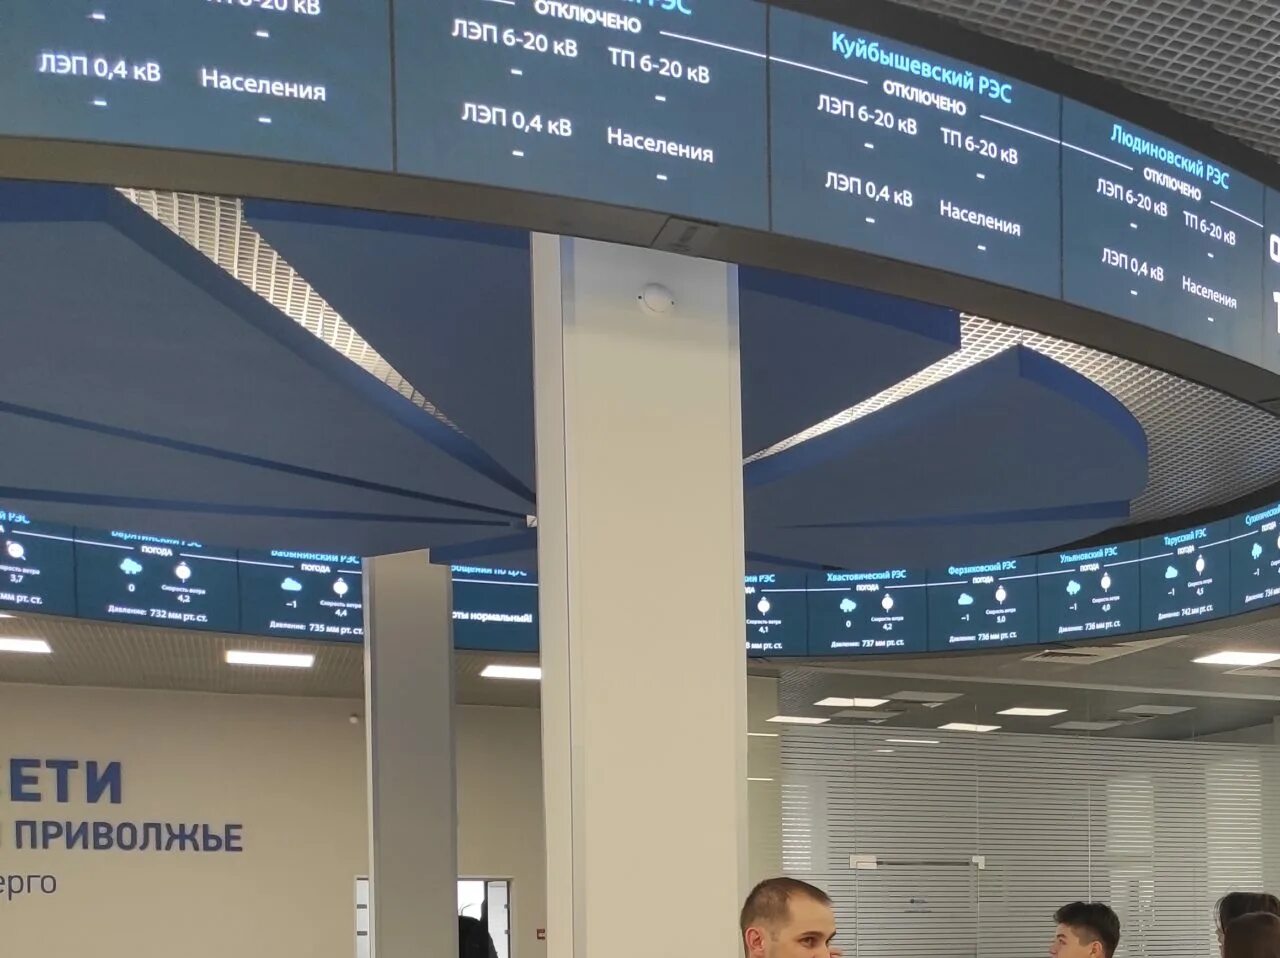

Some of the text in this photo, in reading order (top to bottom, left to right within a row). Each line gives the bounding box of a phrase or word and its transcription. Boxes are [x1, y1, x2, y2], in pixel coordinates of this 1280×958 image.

[535, 0, 642, 33] ОТКЛЮЧЕНО
[452, 18, 578, 57] ЛЭП 6-20 кВ
[38, 52, 161, 82] ЛЭП 0,4 кВ
[608, 46, 711, 84] ТП 6-20 кВ
[831, 31, 1012, 104] Куйбышевский РЭС
[201, 67, 327, 101] Населения
[883, 79, 967, 116] ОТКЛЮЧЕНО
[461, 102, 573, 137] ЛЭП 0,4 кВ
[817, 94, 918, 136] ЛЭП 6-20 кВ
[607, 126, 714, 163] Населения
[940, 127, 1019, 165] ТП 6-20 кВ
[1110, 124, 1230, 190] Людиновский РЭС
[825, 171, 914, 208] ЛЭП 0,4 кВ
[1096, 178, 1168, 218] ЛЭП 6-20 кВ
[1143, 167, 1202, 201] ОТКЛЮЧЕНО
[940, 200, 1021, 237] Населения
[1183, 210, 1236, 246] ТП 6-20 кВ
[1102, 248, 1164, 282] ЛЭП 0,4 кВ
[1182, 275, 1237, 310] Населения
[1195, 528, 1207, 539] РЭС
[141, 545, 173, 557] ПОГОДА
[1002, 560, 1016, 570] РЭС
[1105, 546, 1118, 556] РЭС
[301, 564, 331, 573] ПОГОДА
[759, 574, 776, 583] РЭС
[891, 570, 906, 579] РЭС
[177, 594, 190, 604] 4,2
[856, 584, 879, 592] ПОГОДА
[150, 609, 167, 618] 732
[309, 623, 325, 632] 735
[335, 609, 348, 617] 4,4
[759, 626, 769, 634] 4,1
[10, 759, 122, 804] ЕТИ
[15, 820, 243, 852] ПРИВОЛЖЬЕ
[0, 874, 57, 900] рго
